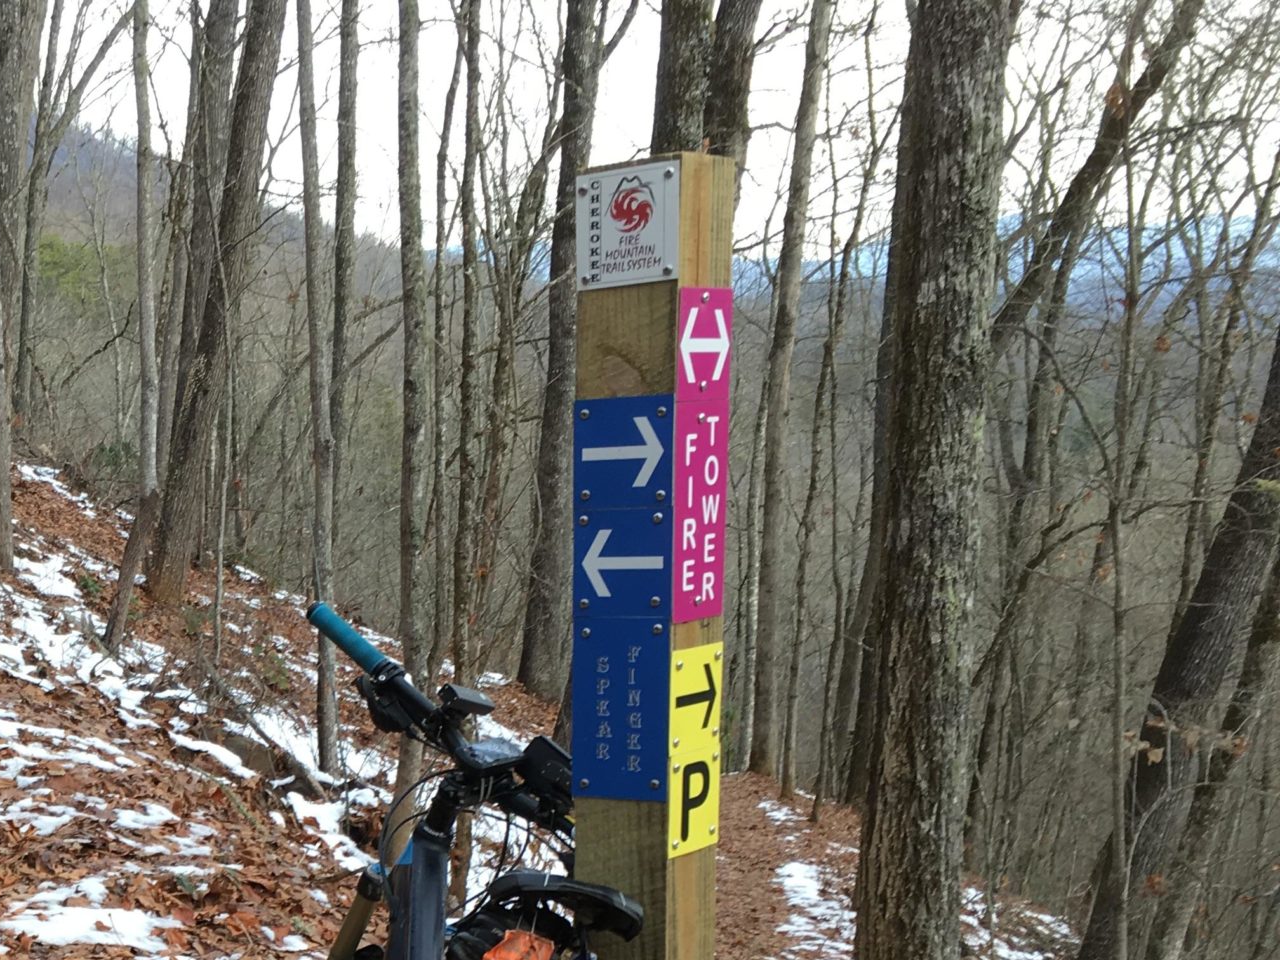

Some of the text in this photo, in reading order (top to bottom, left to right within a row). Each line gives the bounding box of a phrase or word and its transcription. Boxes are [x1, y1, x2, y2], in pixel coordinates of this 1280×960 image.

[589, 180, 601, 283] CHEROKEE
[605, 243, 656, 261] MOUNTAIN
[619, 233, 640, 247] FIRE
[682, 433, 698, 592] FIRE
[701, 416, 720, 602] TOWER
[596, 656, 613, 761] SPEAR
[627, 645, 642, 773] FINGER
[681, 760, 711, 843] P
